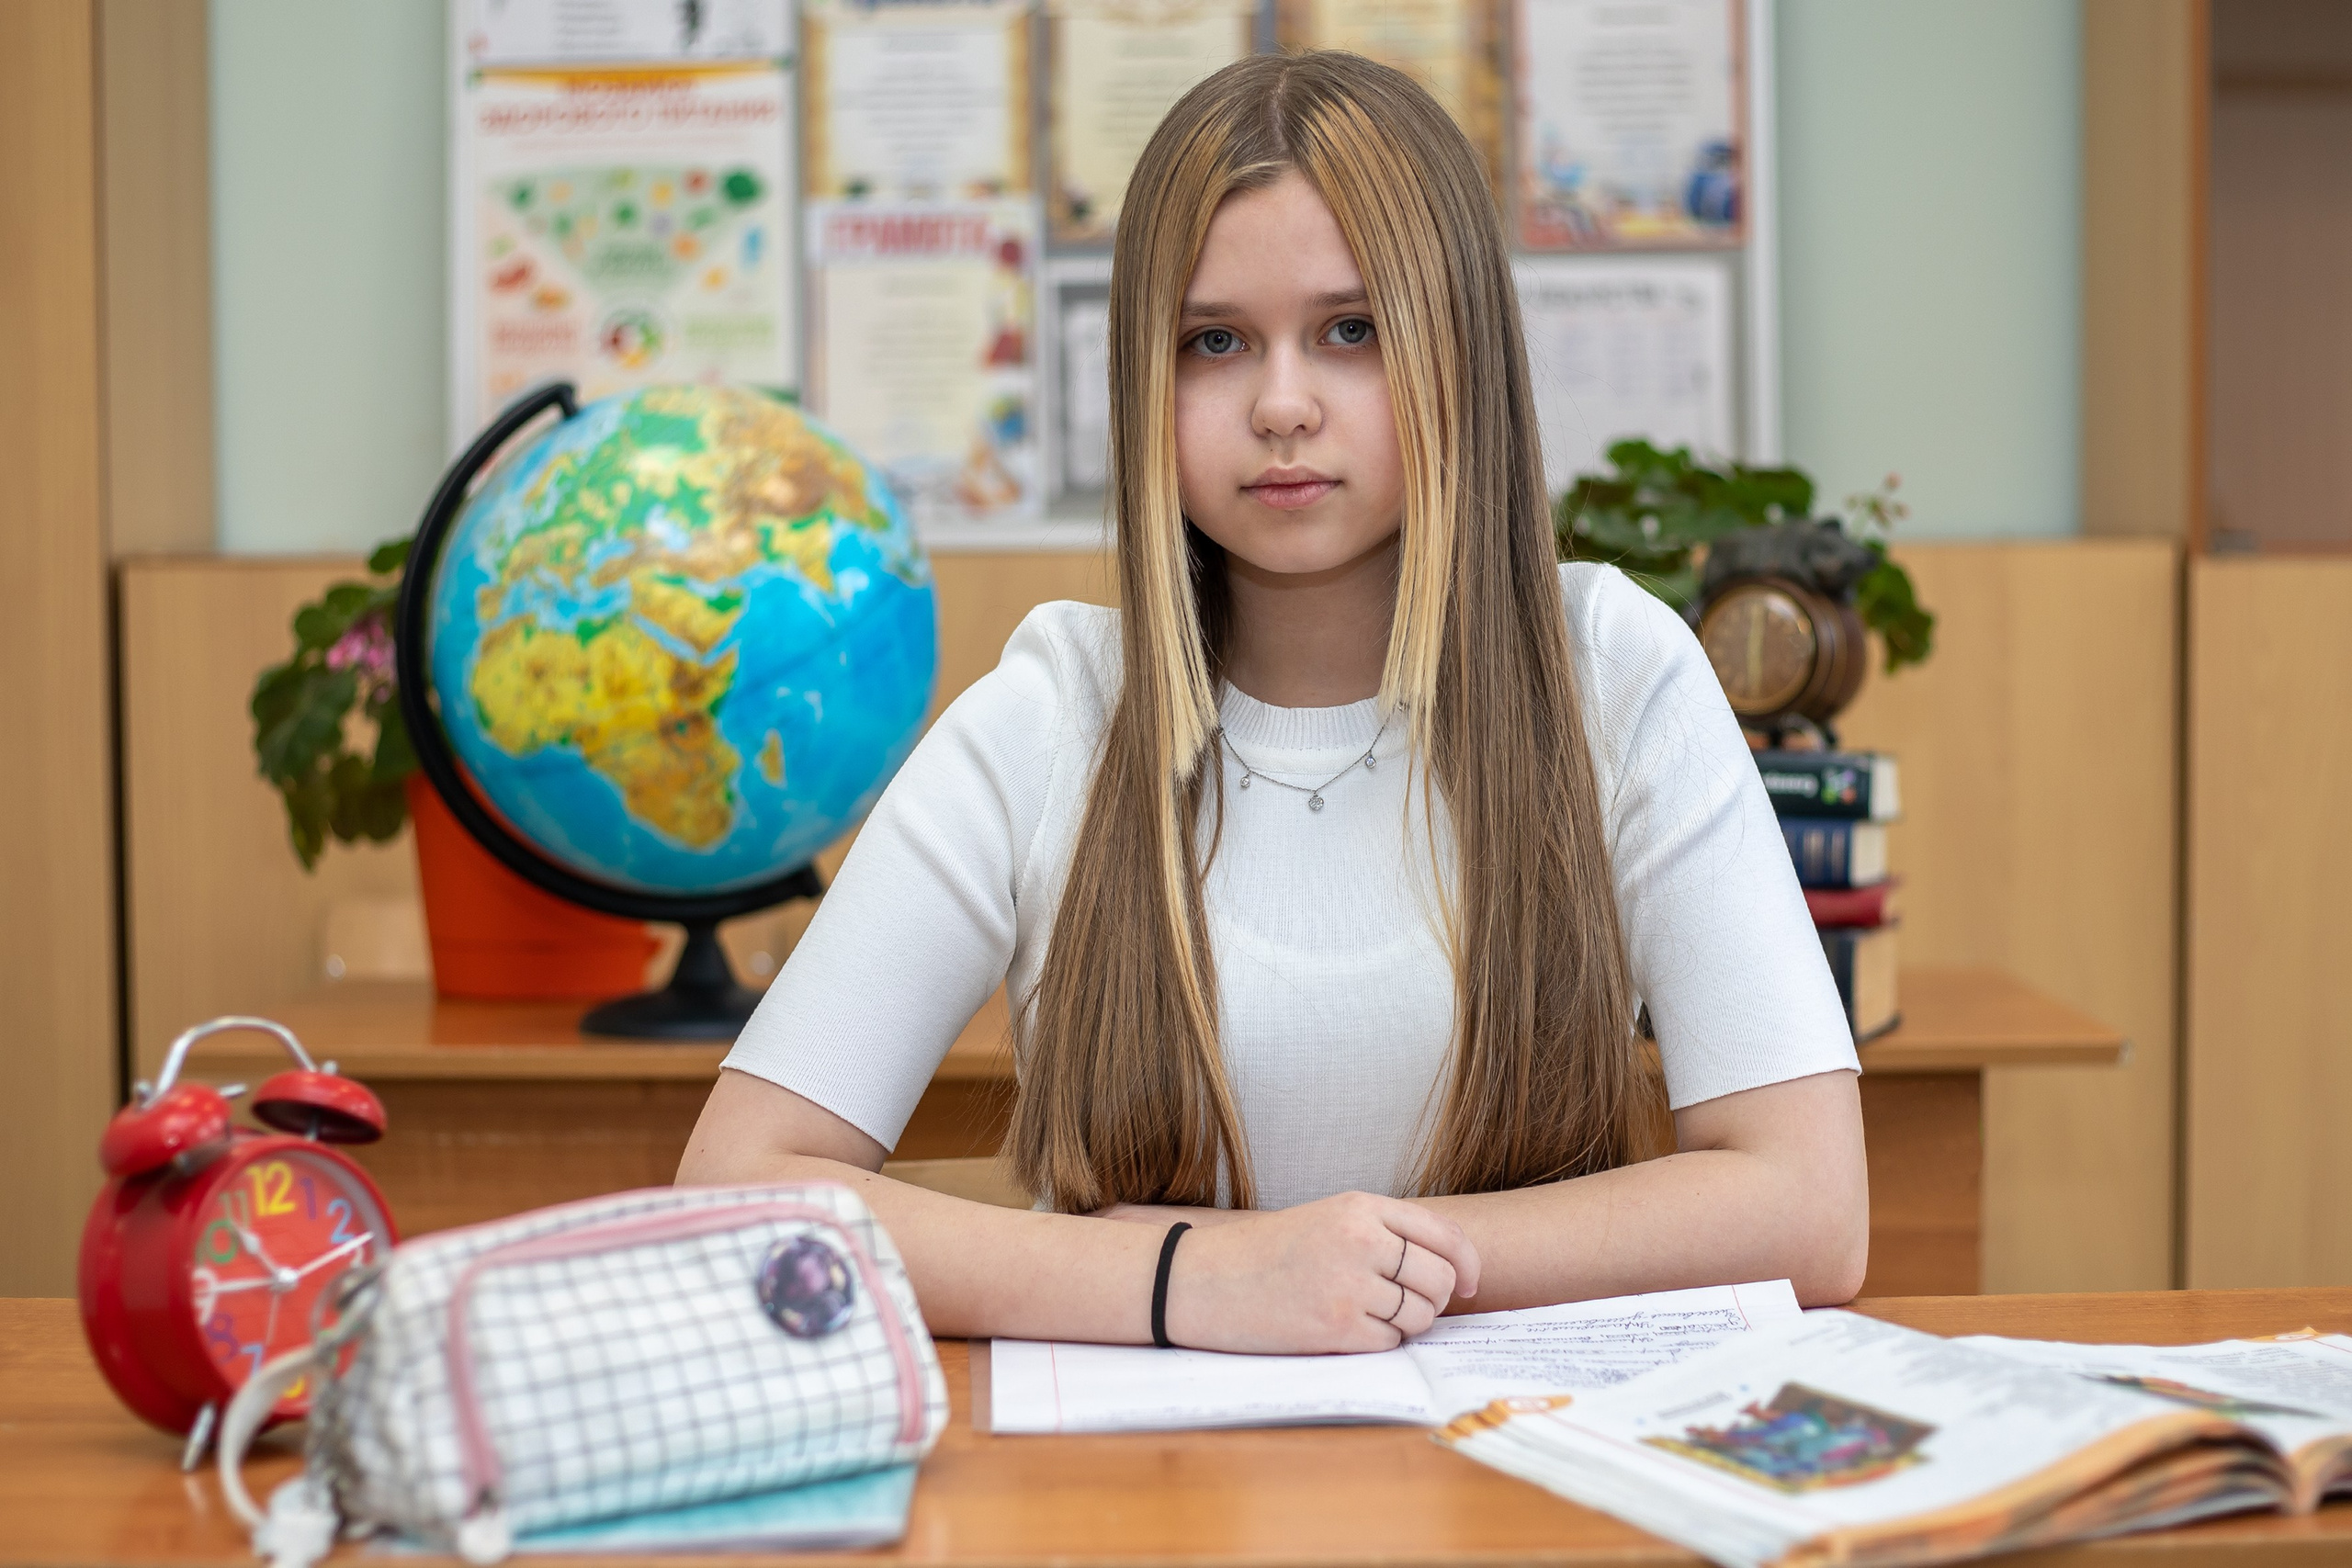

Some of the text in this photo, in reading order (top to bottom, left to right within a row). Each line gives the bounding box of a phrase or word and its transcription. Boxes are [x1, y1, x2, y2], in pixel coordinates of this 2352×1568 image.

[245, 1160, 297, 1217] 12
[300, 1177, 317, 1221] 1
[326, 1198, 356, 1244] 2
[205, 1312, 240, 1363] 8
[240, 1343, 265, 1378] 7
